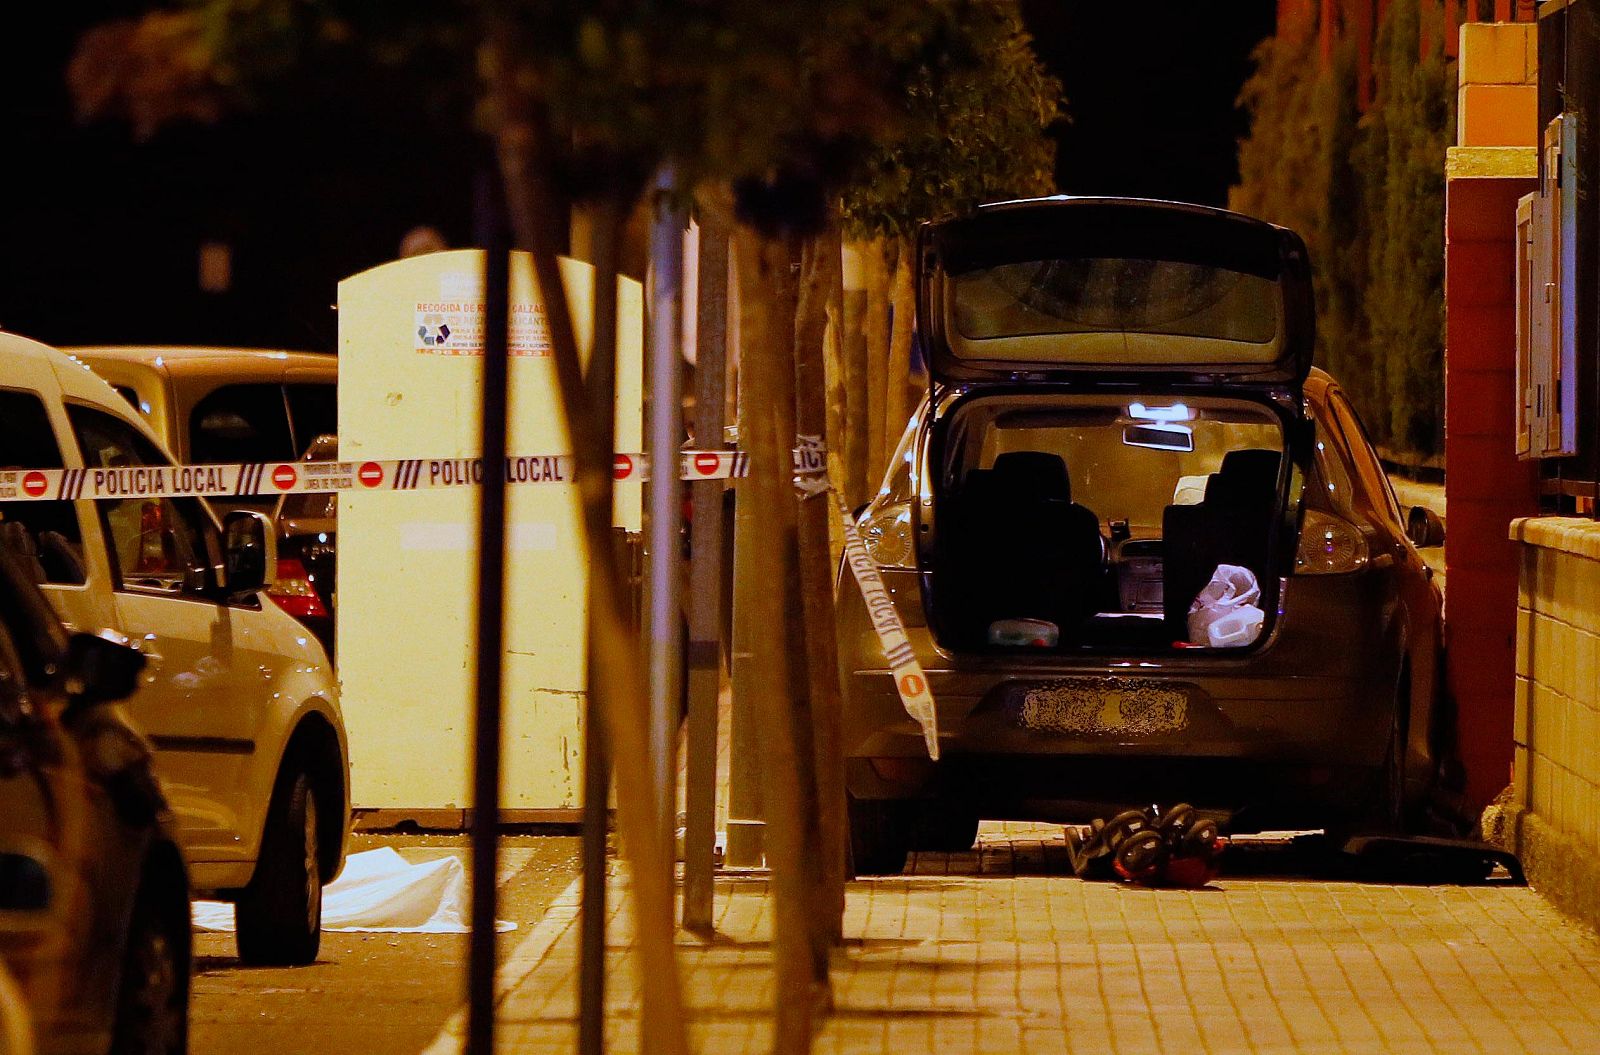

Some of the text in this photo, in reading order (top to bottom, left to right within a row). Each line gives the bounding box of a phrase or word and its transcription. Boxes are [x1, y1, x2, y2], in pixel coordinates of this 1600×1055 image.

[416, 303, 460, 312] RECOGIDA
[463, 304, 476, 312] DE
[512, 304, 546, 313] CALZAD
[94, 467, 227, 495] POLICIA LOCAL
[430, 457, 563, 485] POLIC LOCAL
